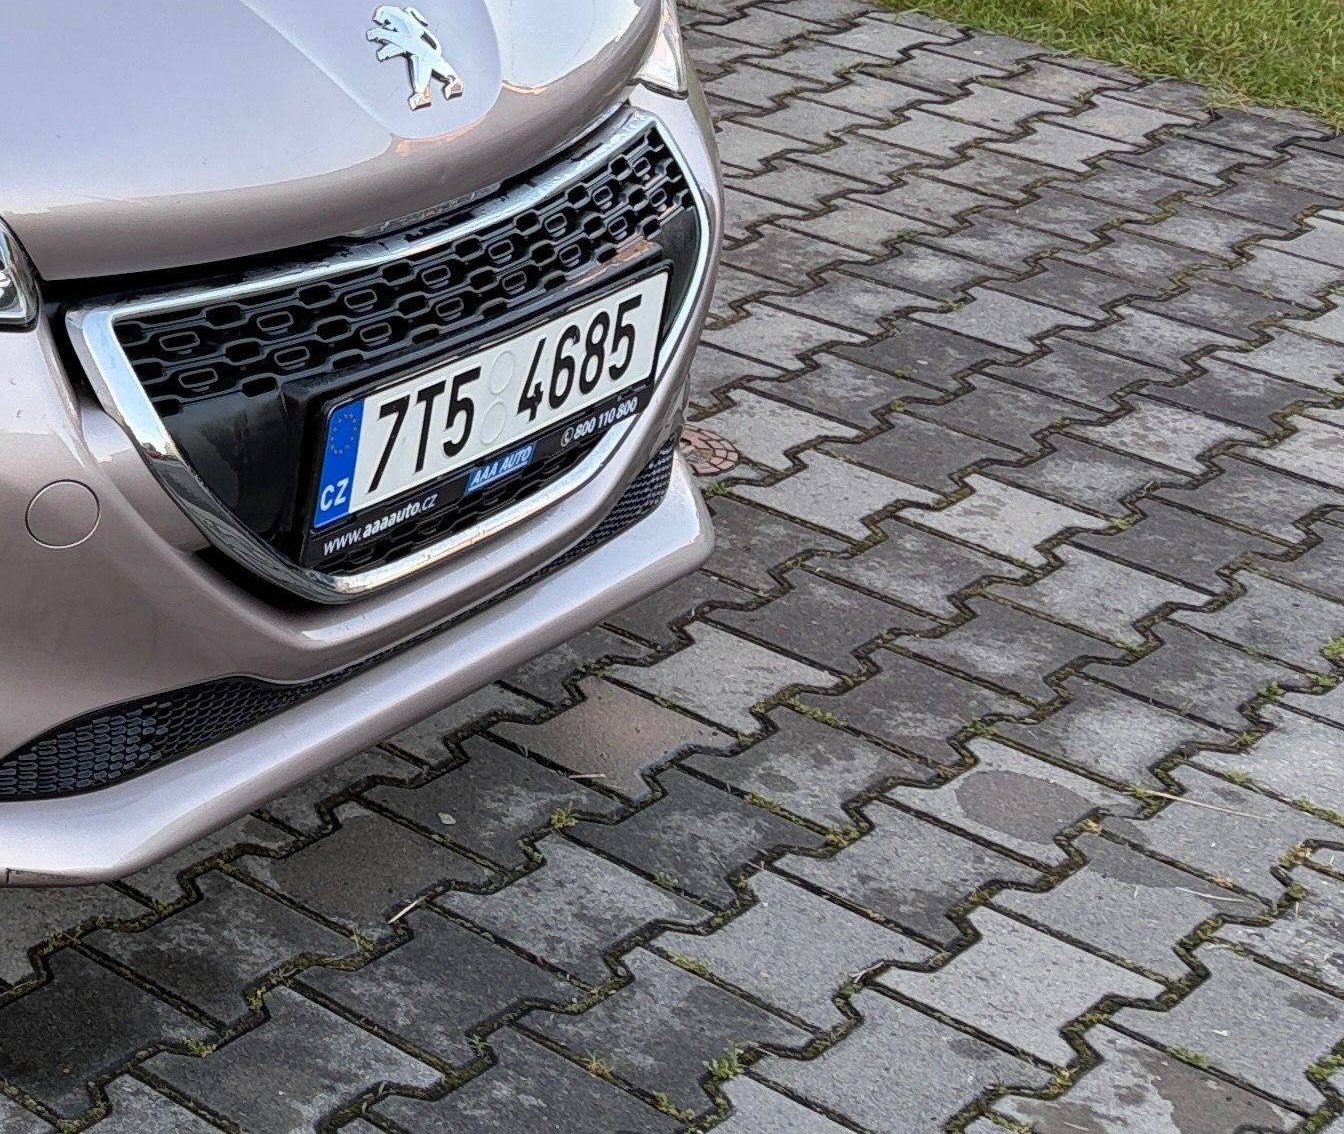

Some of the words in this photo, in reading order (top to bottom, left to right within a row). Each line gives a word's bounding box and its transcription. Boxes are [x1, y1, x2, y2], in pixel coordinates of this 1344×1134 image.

[368, 366, 481, 494] 7T5
[517, 294, 643, 422] 4685
[573, 416, 596, 440] 800
[597, 407, 616, 429] 110
[616, 396, 639, 418] 800
[472, 461, 499, 487] AAA
[498, 445, 534, 474] AUTO
[320, 477, 348, 512] CZ
[323, 493, 438, 556] www.aaaauto.cz
